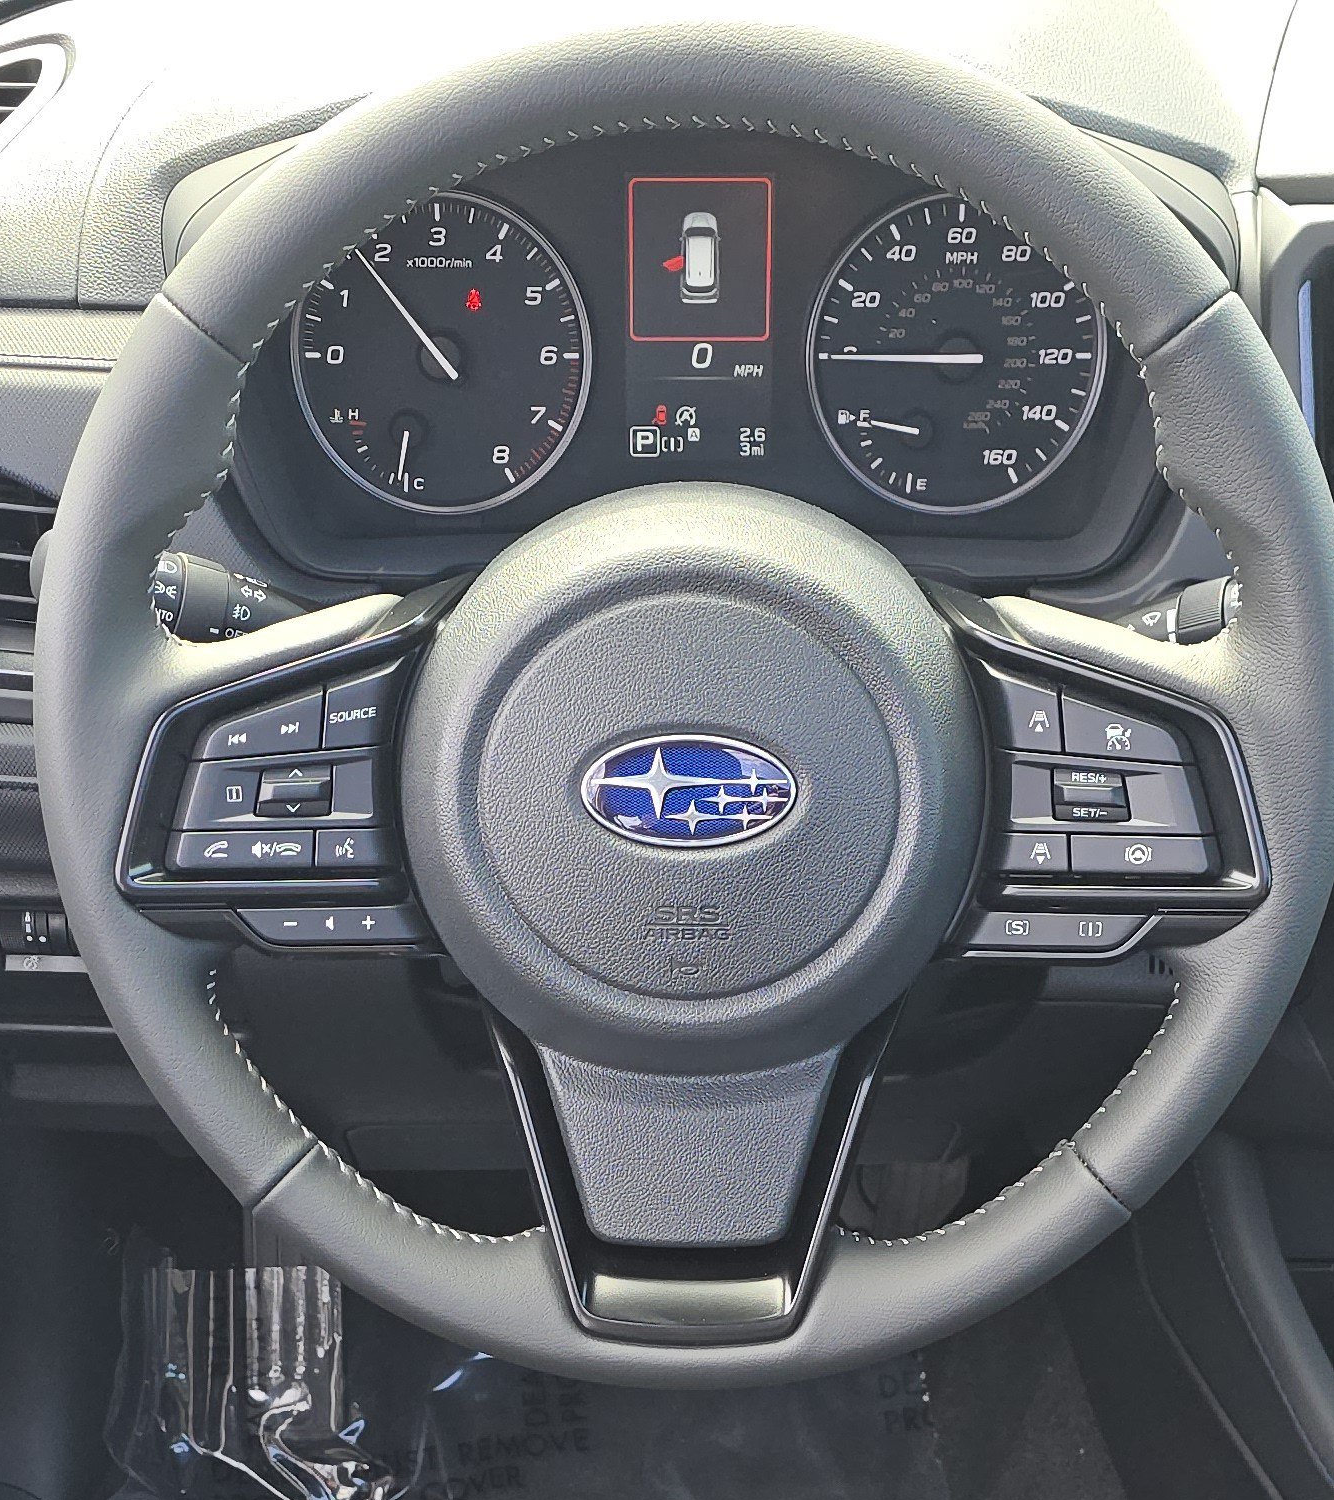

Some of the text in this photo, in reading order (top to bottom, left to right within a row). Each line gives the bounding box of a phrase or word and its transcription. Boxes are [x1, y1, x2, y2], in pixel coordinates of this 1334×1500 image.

[428, 227, 447, 246] 3
[947, 227, 977, 244] 60
[373, 243, 392, 262] 2
[485, 244, 503, 263] 4
[886, 245, 916, 261] 40
[945, 252, 978, 264] MPH
[1001, 245, 1031, 262] 80
[406, 257, 472, 269] x1000r/min
[952, 278, 974, 289] 100
[975, 284, 996, 294] 120
[339, 290, 349, 308] 1
[524, 286, 543, 305] 5
[851, 291, 881, 308] 20
[913, 292, 931, 304] 60
[992, 297, 1012, 307] 140
[1029, 291, 1066, 308] 100
[898, 307, 916, 318] 40
[326, 345, 345, 364] 0
[539, 346, 558, 365] 6
[691, 342, 713, 369] 0
[1038, 347, 1073, 365] 120
[733, 364, 764, 377] MPH
[348, 408, 359, 420] H
[530, 406, 547, 424] 7
[859, 409, 871, 422] F
[1022, 404, 1057, 421] 140
[636, 431, 654, 452] P
[739, 427, 766, 442] 2.6
[492, 445, 510, 464] 8
[982, 448, 1017, 465] 160
[413, 477, 424, 489] C
[916, 478, 928, 490] E
[328, 706, 378, 725] SOURCE
[1071, 772, 1107, 783] RES/+
[655, 905, 722, 925] SRS
[645, 927, 731, 941] AIRBAG
